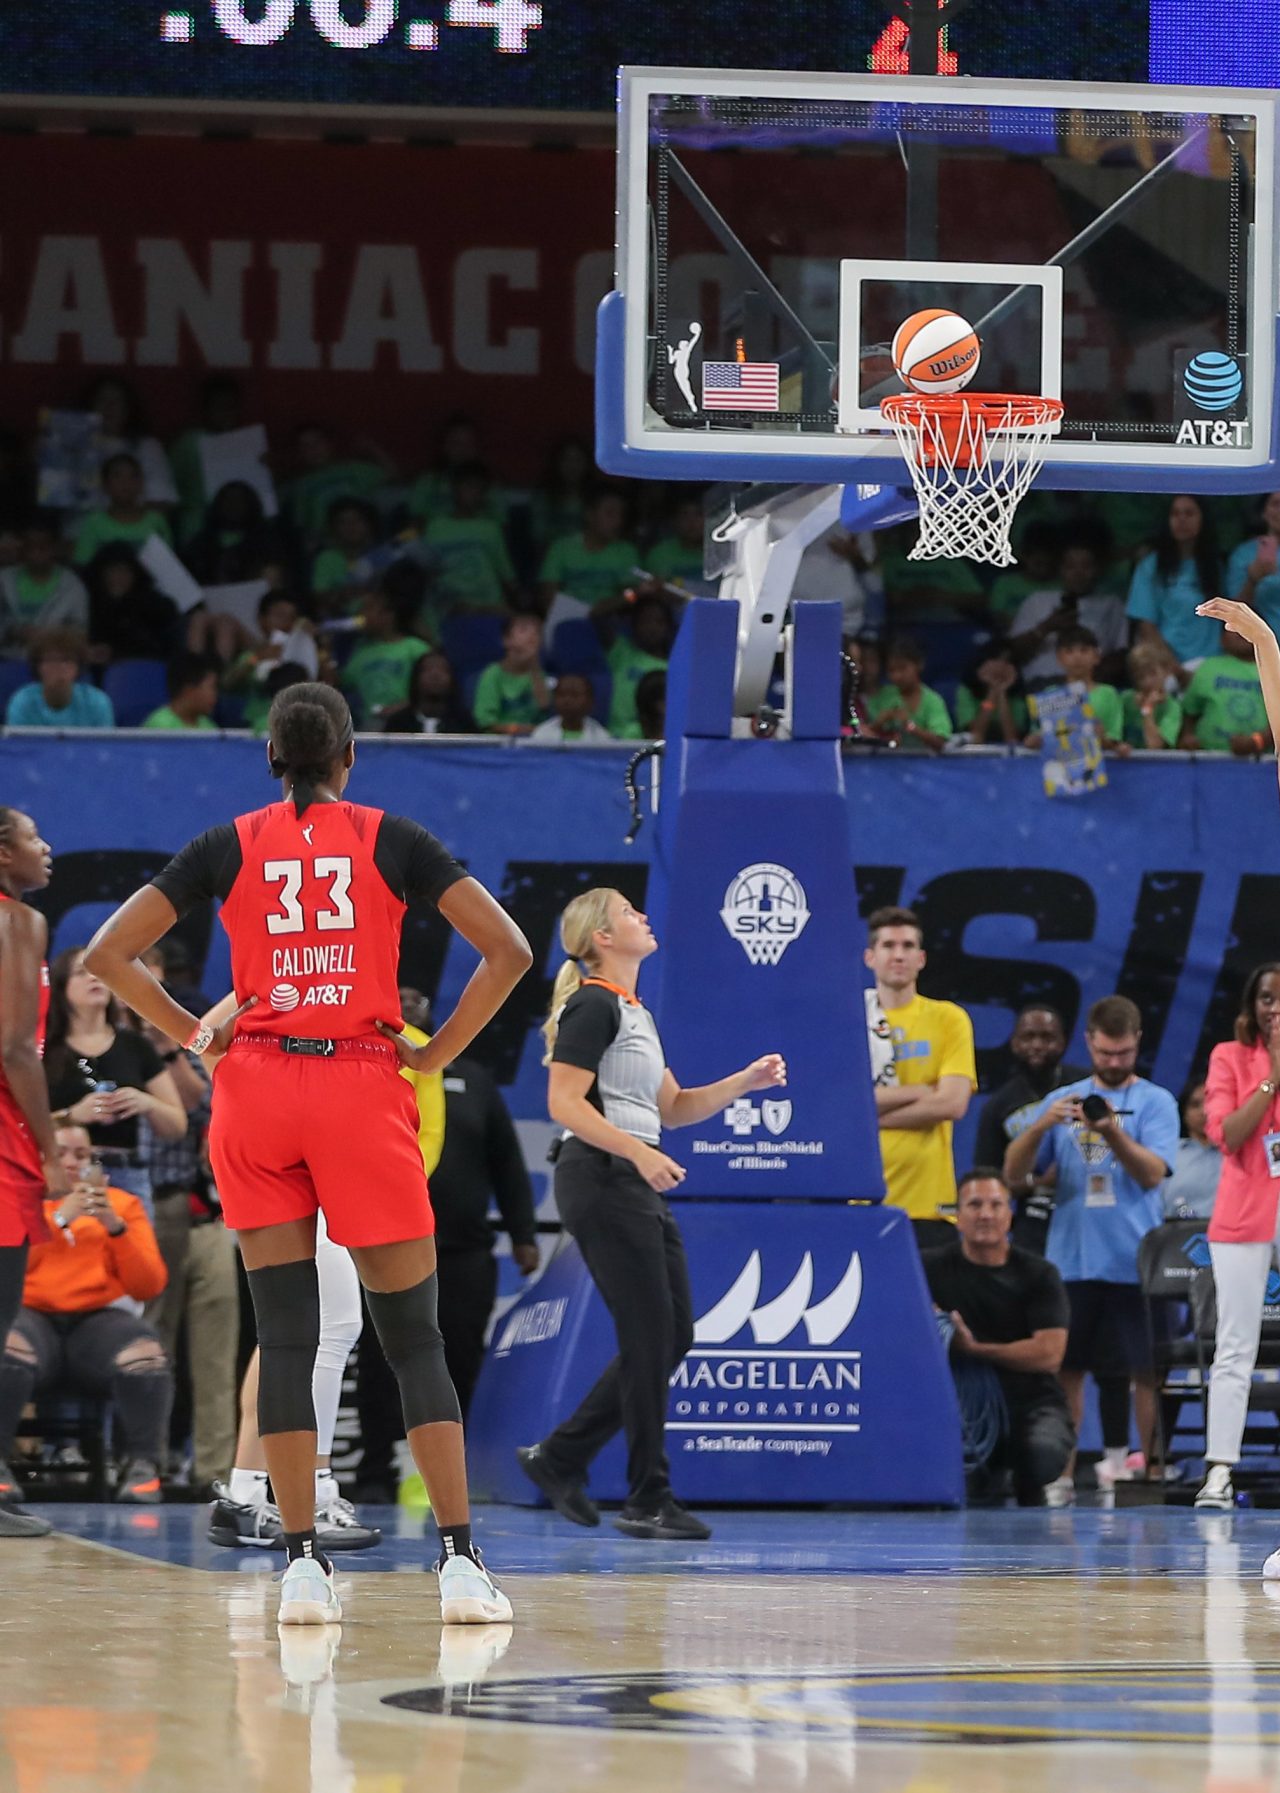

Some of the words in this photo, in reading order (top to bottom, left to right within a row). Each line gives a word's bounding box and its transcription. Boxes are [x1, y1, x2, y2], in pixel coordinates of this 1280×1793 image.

[929, 347, 977, 376] Wilson
[1176, 419, 1249, 446] AT&T
[263, 856, 355, 935] 33
[735, 915, 797, 934] SKY
[272, 944, 356, 978] CALDWELL
[302, 984, 353, 1007] AT&T
[668, 1360, 861, 1390] MAGELLAN
[675, 1401, 860, 1416] ORPORATION
[683, 1438, 695, 1451] a
[696, 1435, 763, 1452] SeaTrade
[764, 1438, 832, 1456] company
